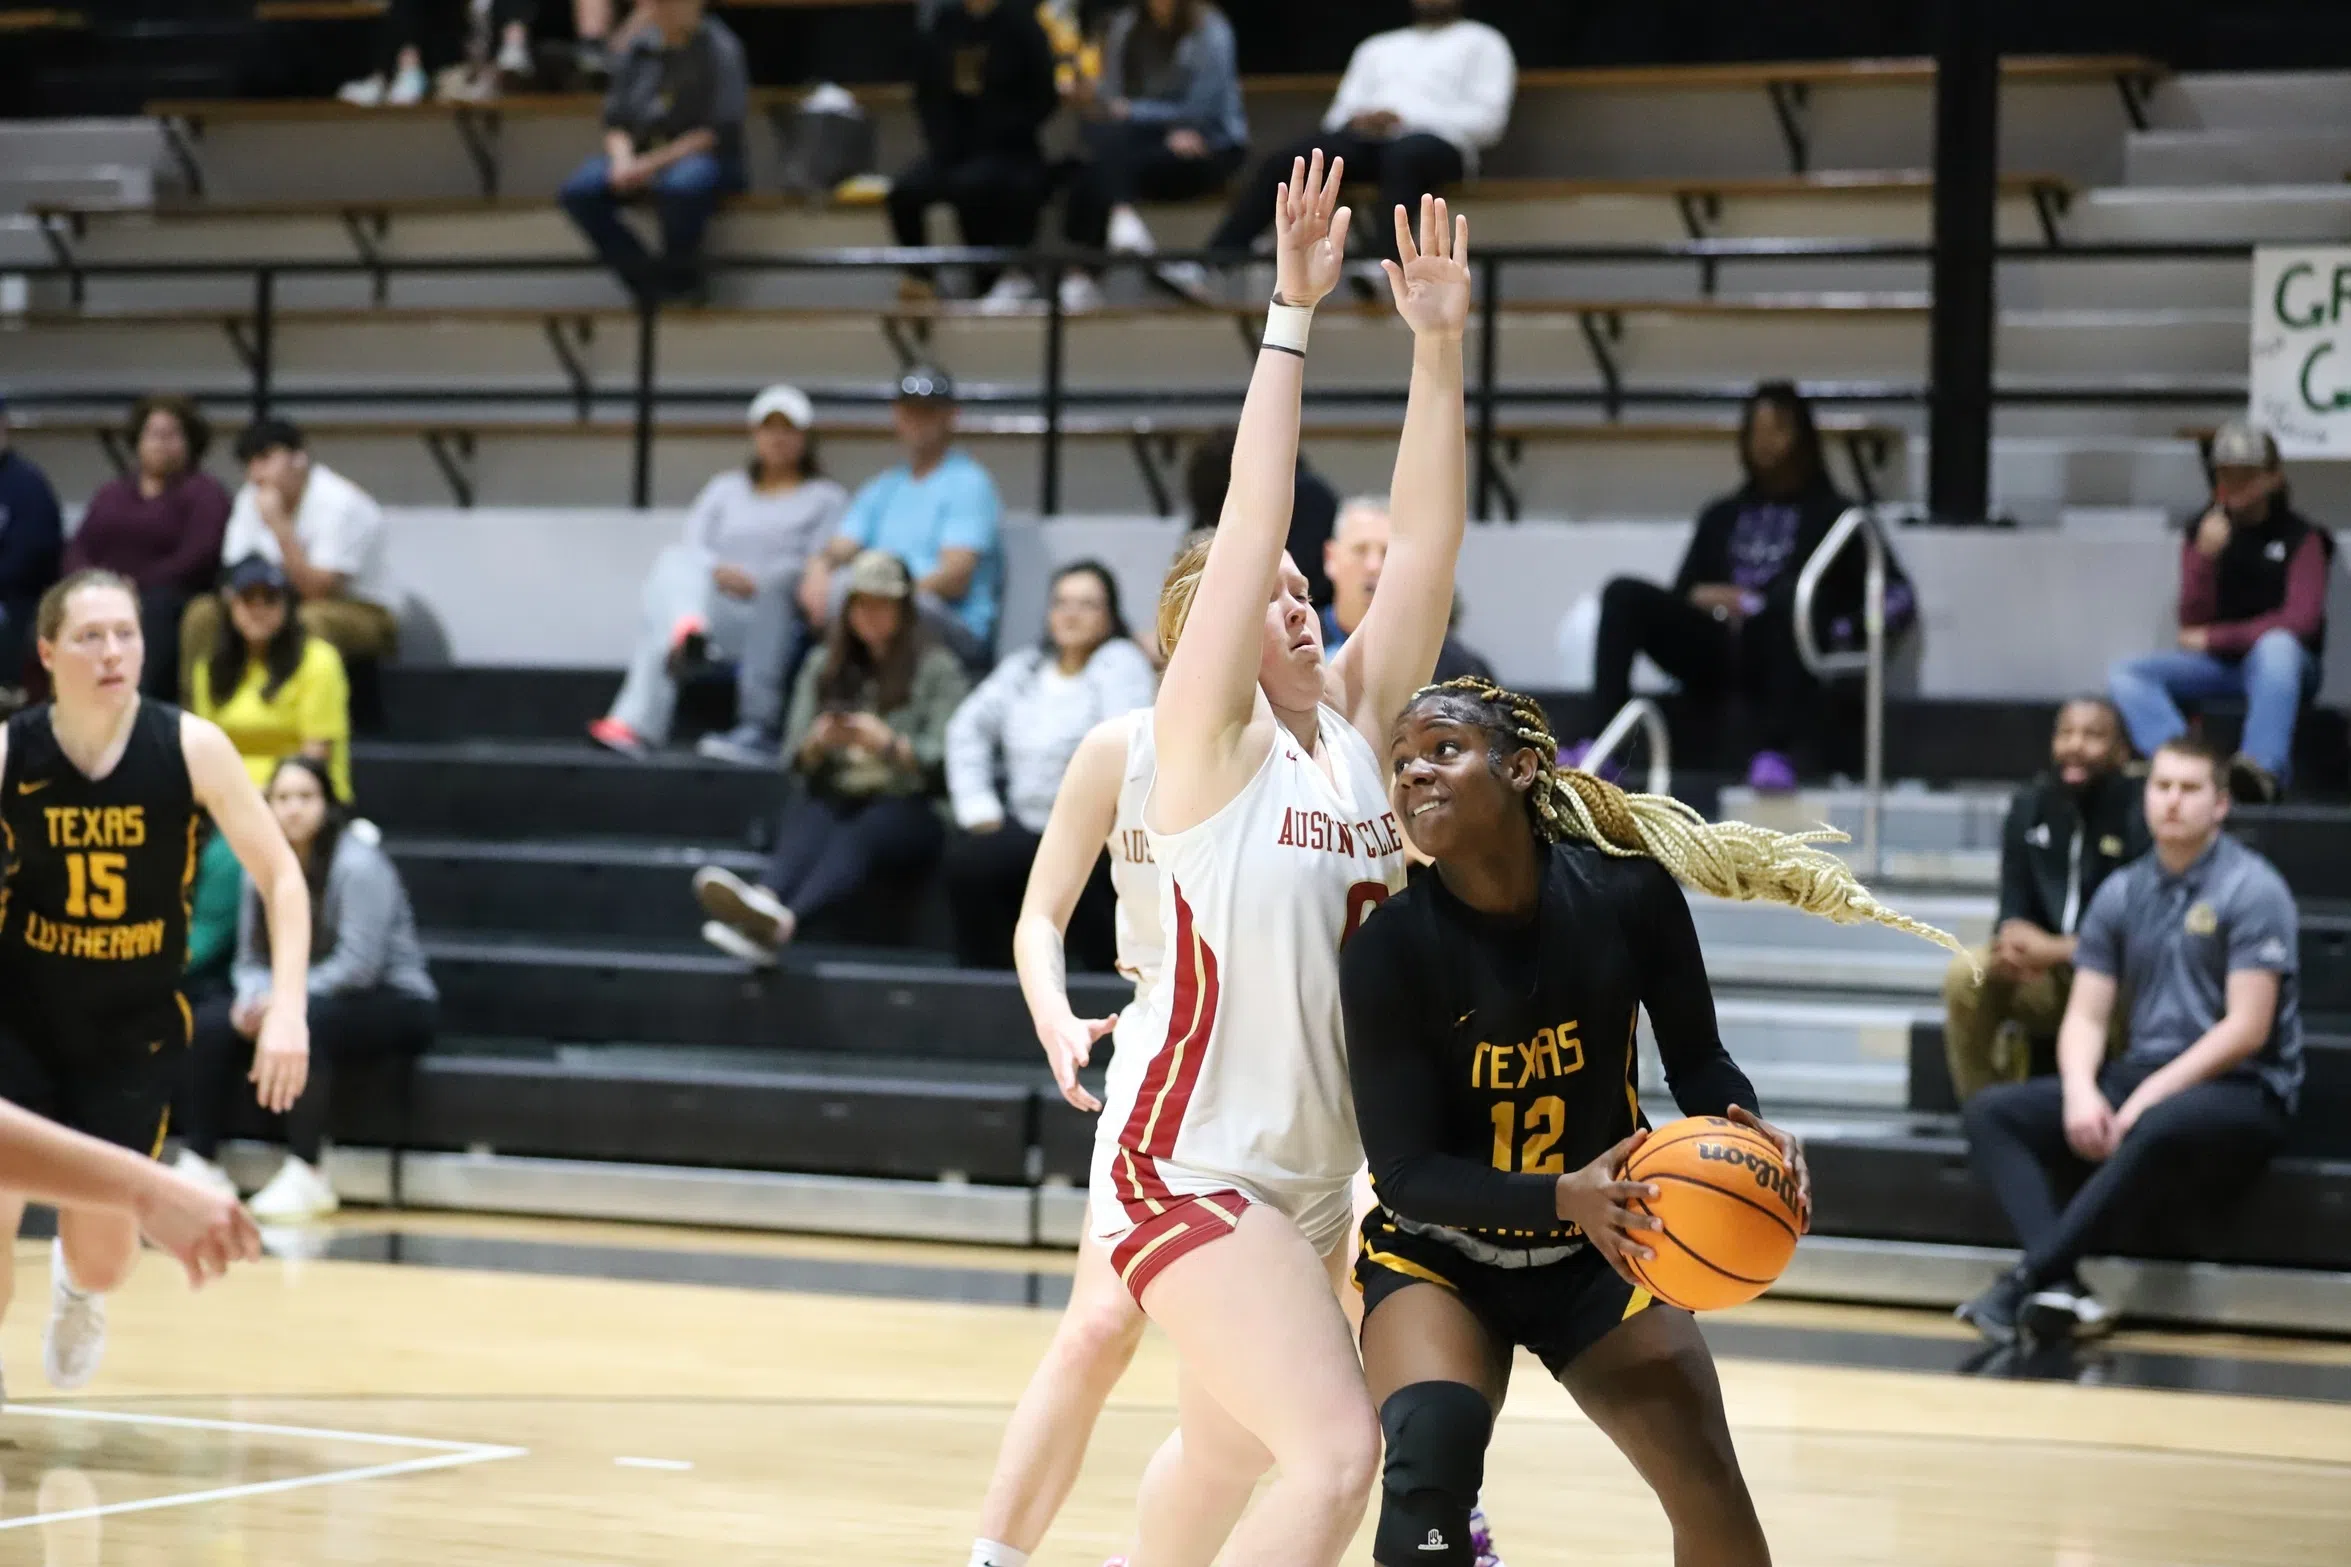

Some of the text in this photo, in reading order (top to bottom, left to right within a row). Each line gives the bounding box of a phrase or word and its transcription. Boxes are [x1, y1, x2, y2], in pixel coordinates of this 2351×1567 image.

[43, 805, 146, 847] TEXAS
[1277, 806, 1355, 859] AUSTN
[65, 852, 127, 920] 15
[24, 910, 165, 960] LUTHERAN
[1472, 1019, 1585, 1089] TEXAS
[1491, 1095, 1565, 1175] 12
[1699, 1144, 1799, 1219] Wilson
